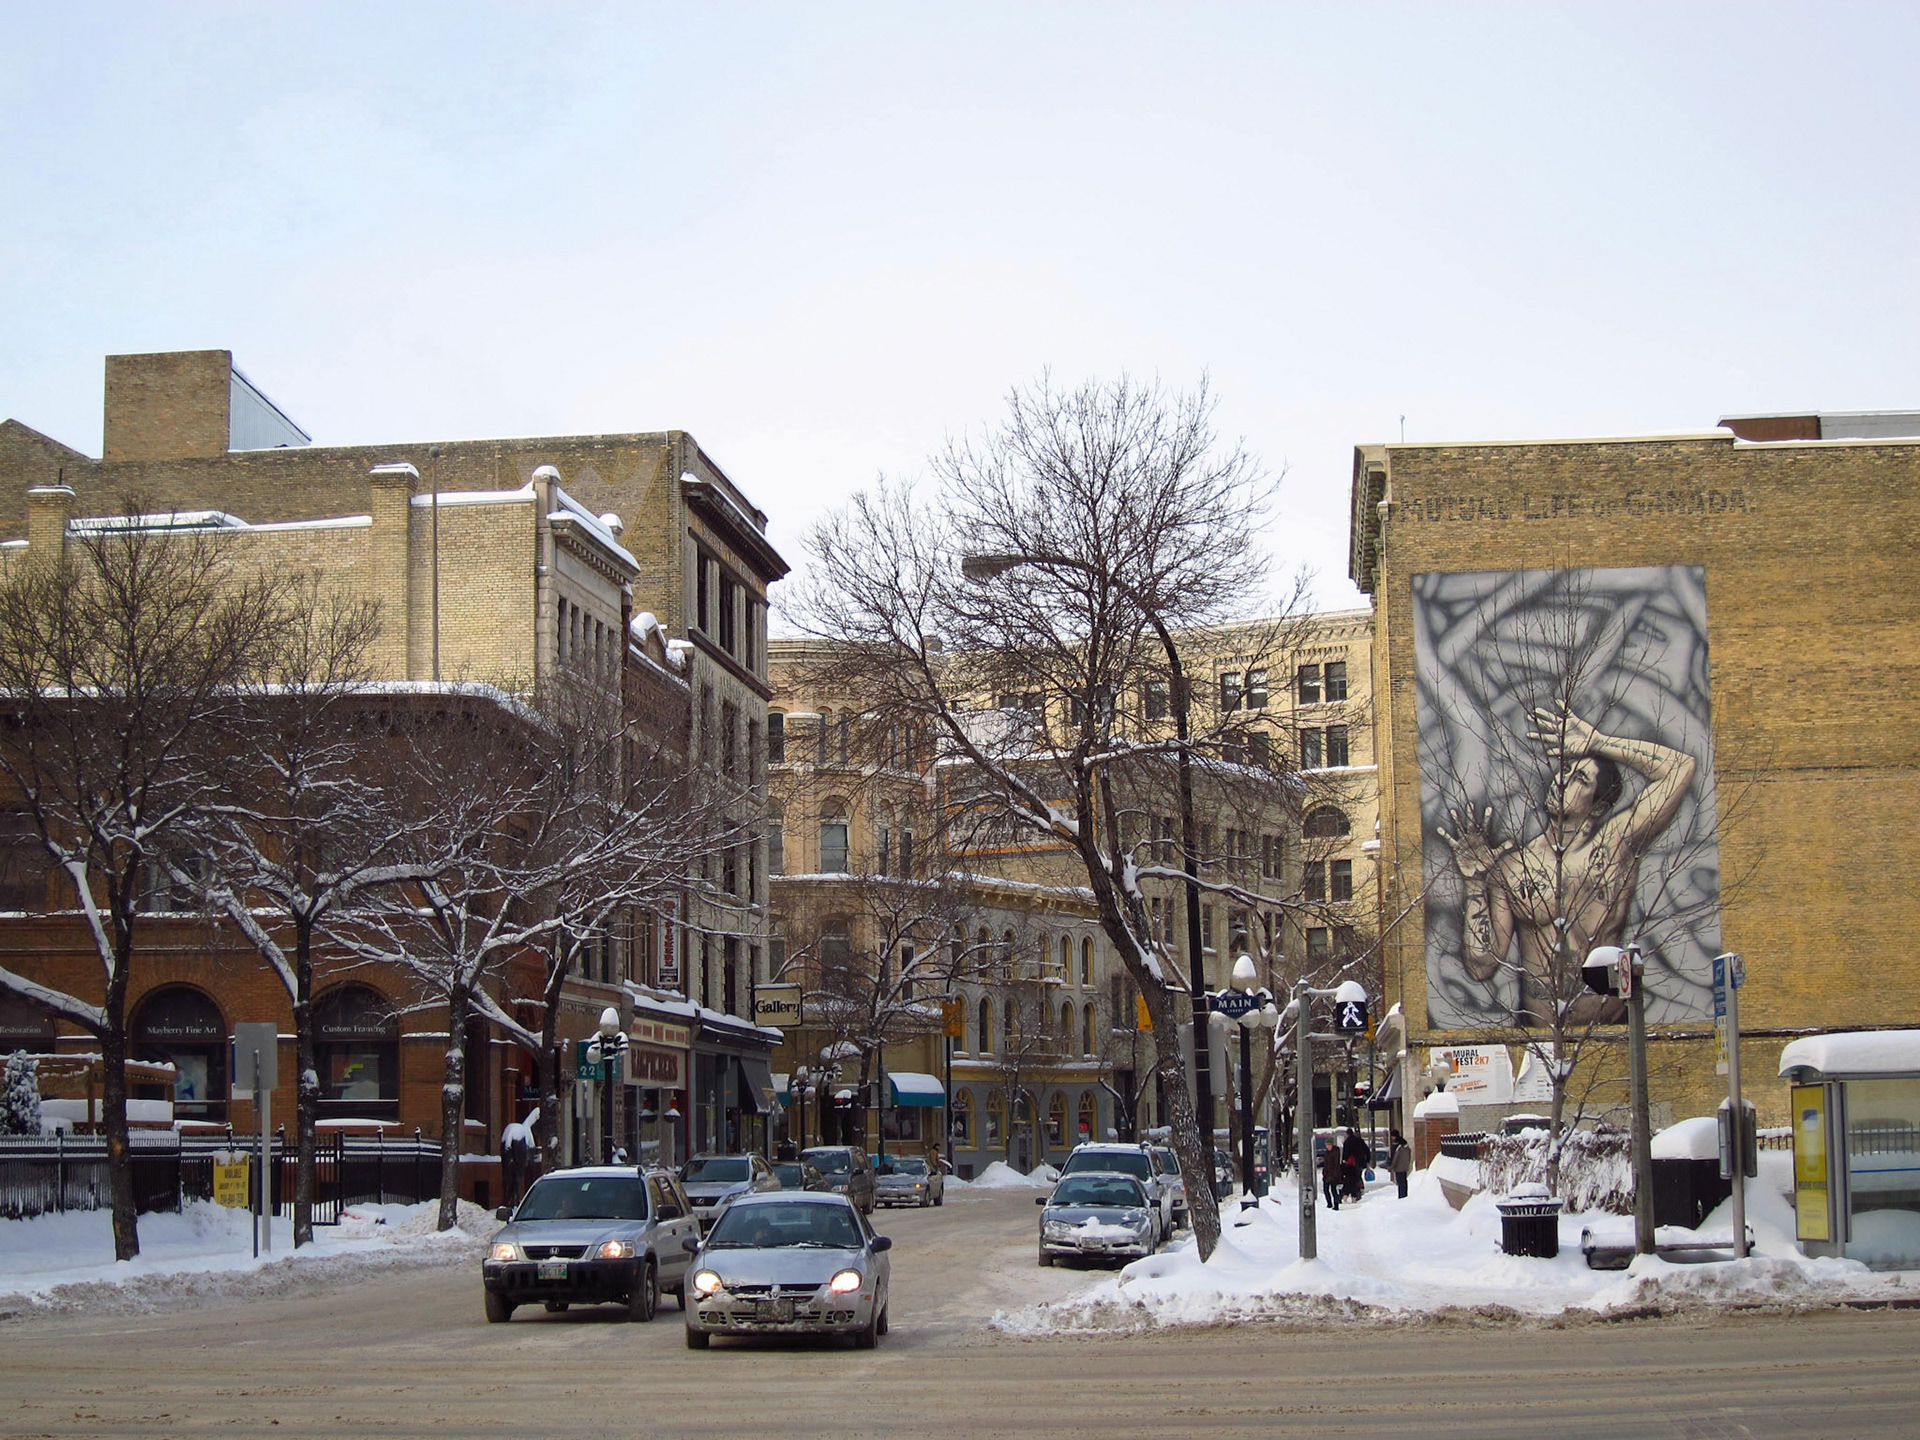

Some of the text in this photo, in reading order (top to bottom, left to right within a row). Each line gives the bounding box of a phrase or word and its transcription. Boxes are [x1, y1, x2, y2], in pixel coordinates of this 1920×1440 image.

[1400, 497, 1511, 522] MUTUAL
[1218, 999, 1252, 1008] MAIN
[756, 1000, 799, 1019] Gallery
[147, 1026, 217, 1036] Mayberry Fine Art
[322, 1025, 386, 1035] Custom Framing
[1453, 1049, 1479, 1058] MURAL
[1456, 1056, 1490, 1066] FEST 2K7
